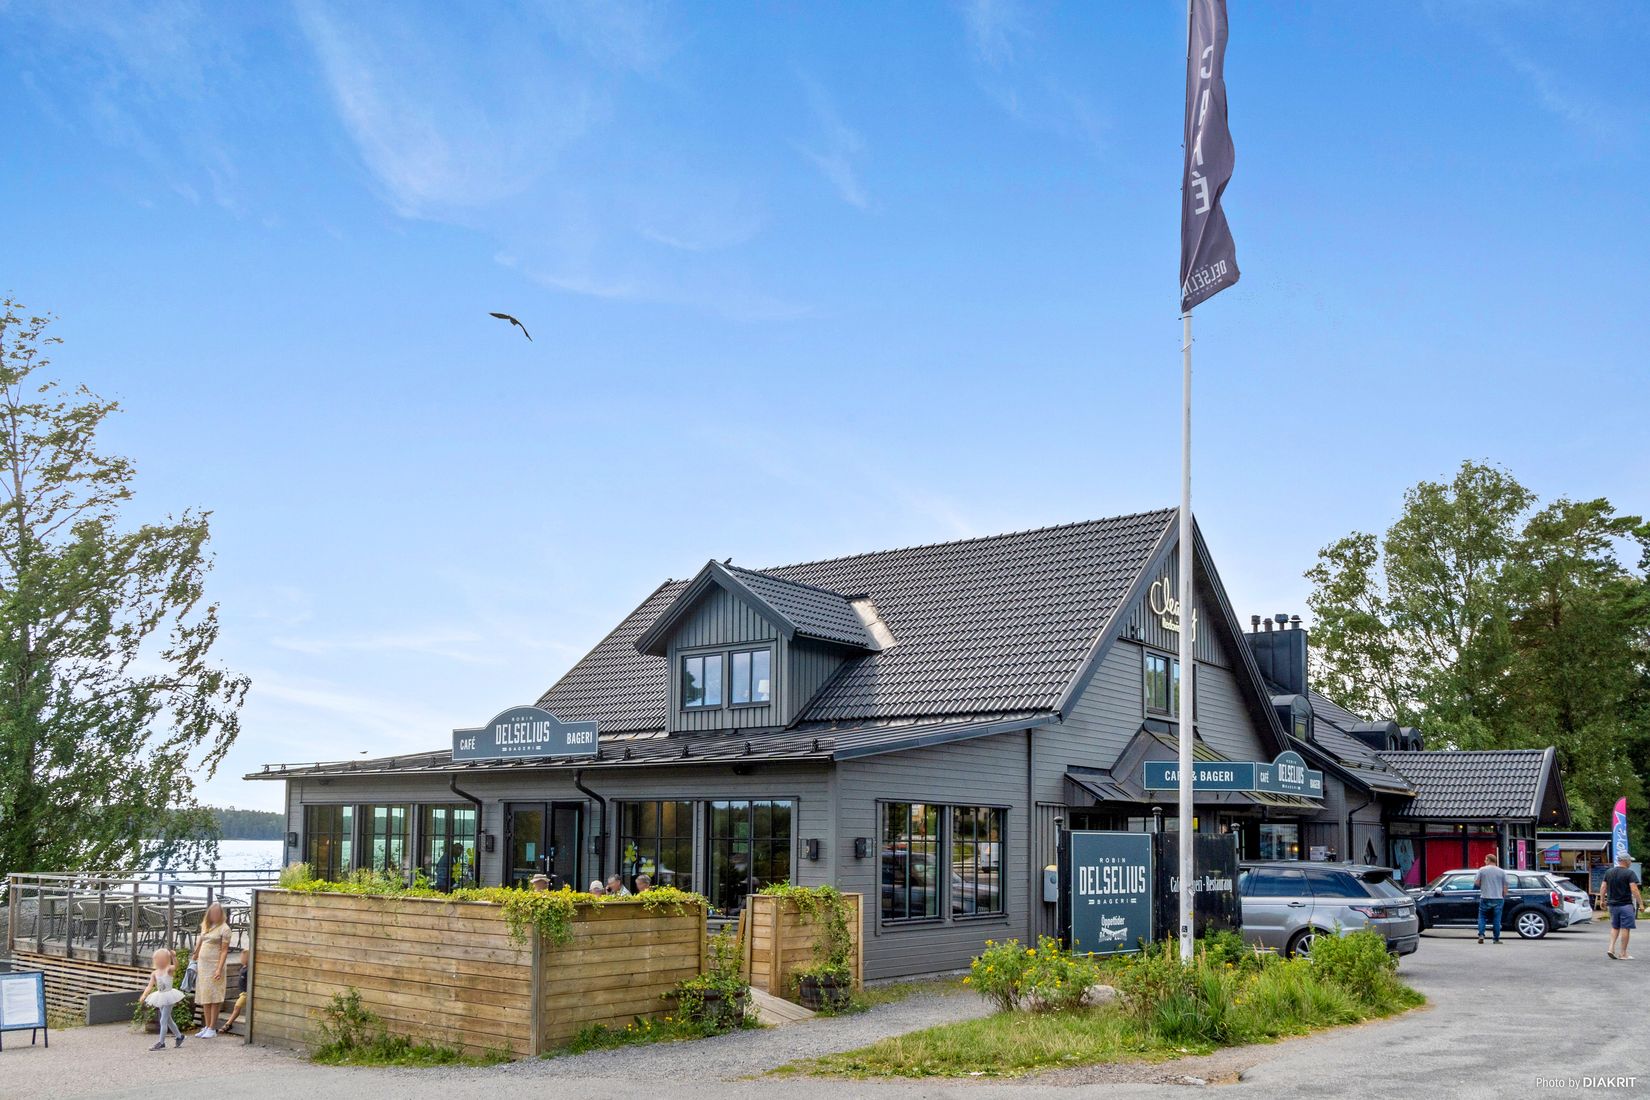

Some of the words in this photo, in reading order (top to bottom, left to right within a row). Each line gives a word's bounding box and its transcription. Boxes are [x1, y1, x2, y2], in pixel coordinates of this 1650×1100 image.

[496, 721, 550, 745] DELSELIUS
[566, 732, 592, 744] BAGERI
[460, 736, 476, 750] CAFÉ
[1200, 770, 1233, 782] BAGERI
[1278, 764, 1304, 784] DELSELIUS
[1080, 866, 1146, 896] DELSELIUS
